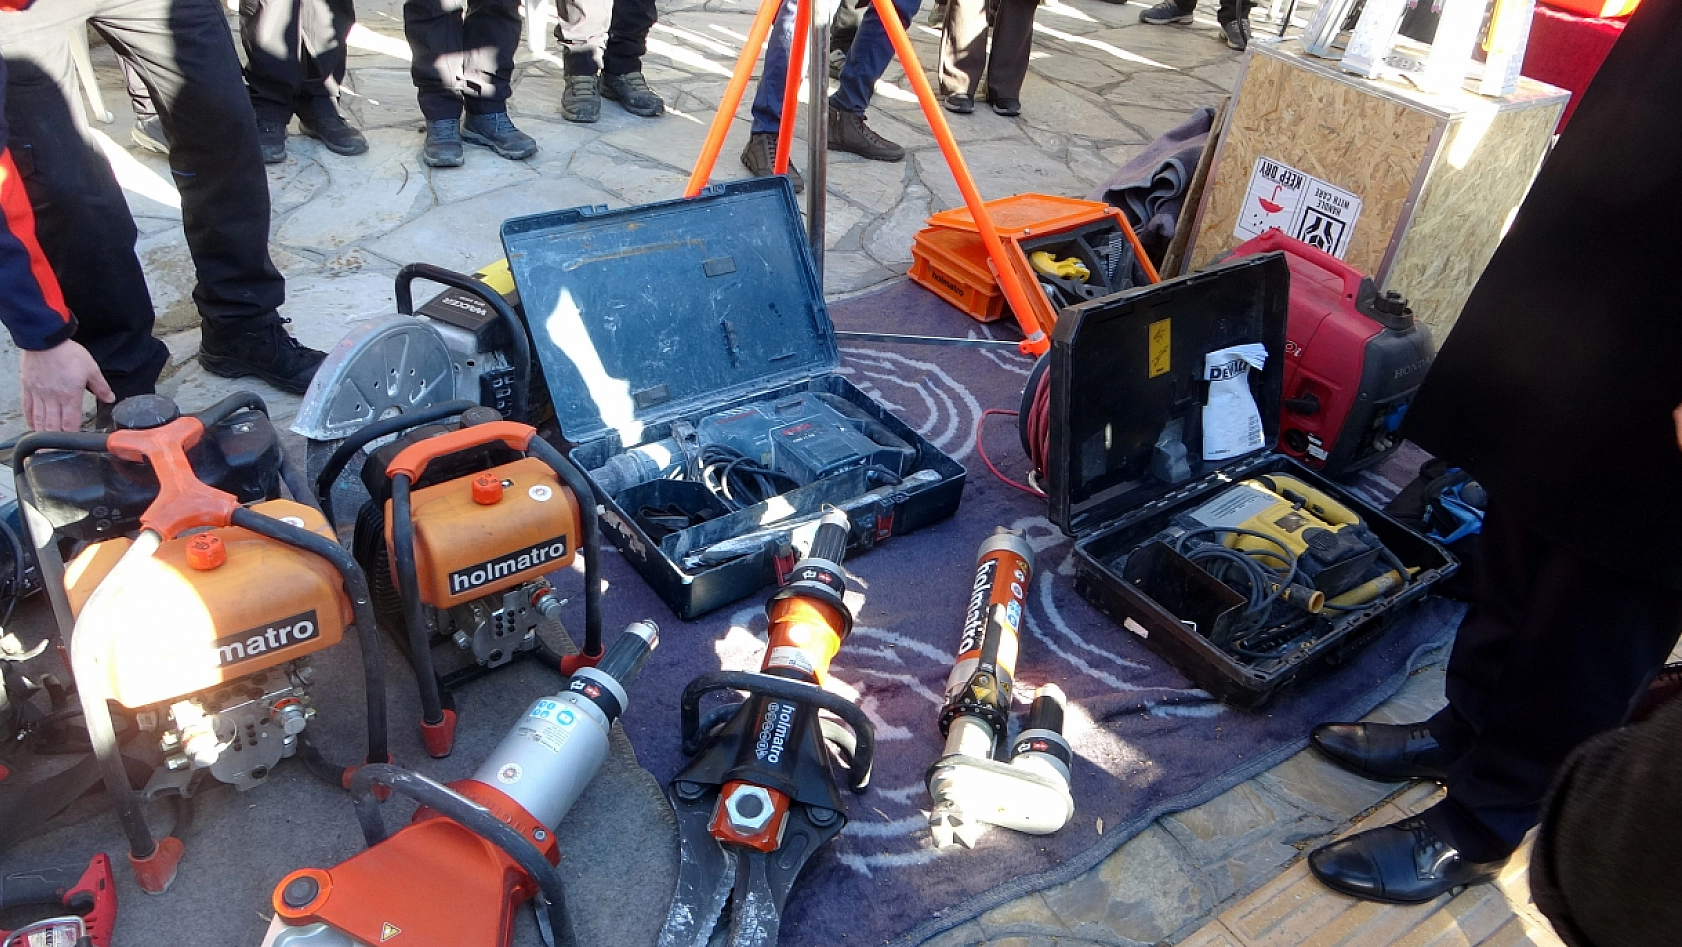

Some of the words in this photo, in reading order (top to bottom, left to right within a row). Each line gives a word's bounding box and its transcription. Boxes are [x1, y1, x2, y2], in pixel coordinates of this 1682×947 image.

[1259, 161, 1279, 179] DRY
[1279, 170, 1304, 190] KEEP
[1314, 187, 1332, 202] CARE
[1333, 196, 1350, 210] WITH
[1316, 200, 1342, 216] HANDLE
[931, 270, 965, 298] holmatro
[441, 297, 487, 316] WACKER
[453, 543, 565, 592] holmatro
[958, 560, 996, 655] holmatro
[219, 620, 315, 665] matro
[767, 703, 797, 763] holmatro
